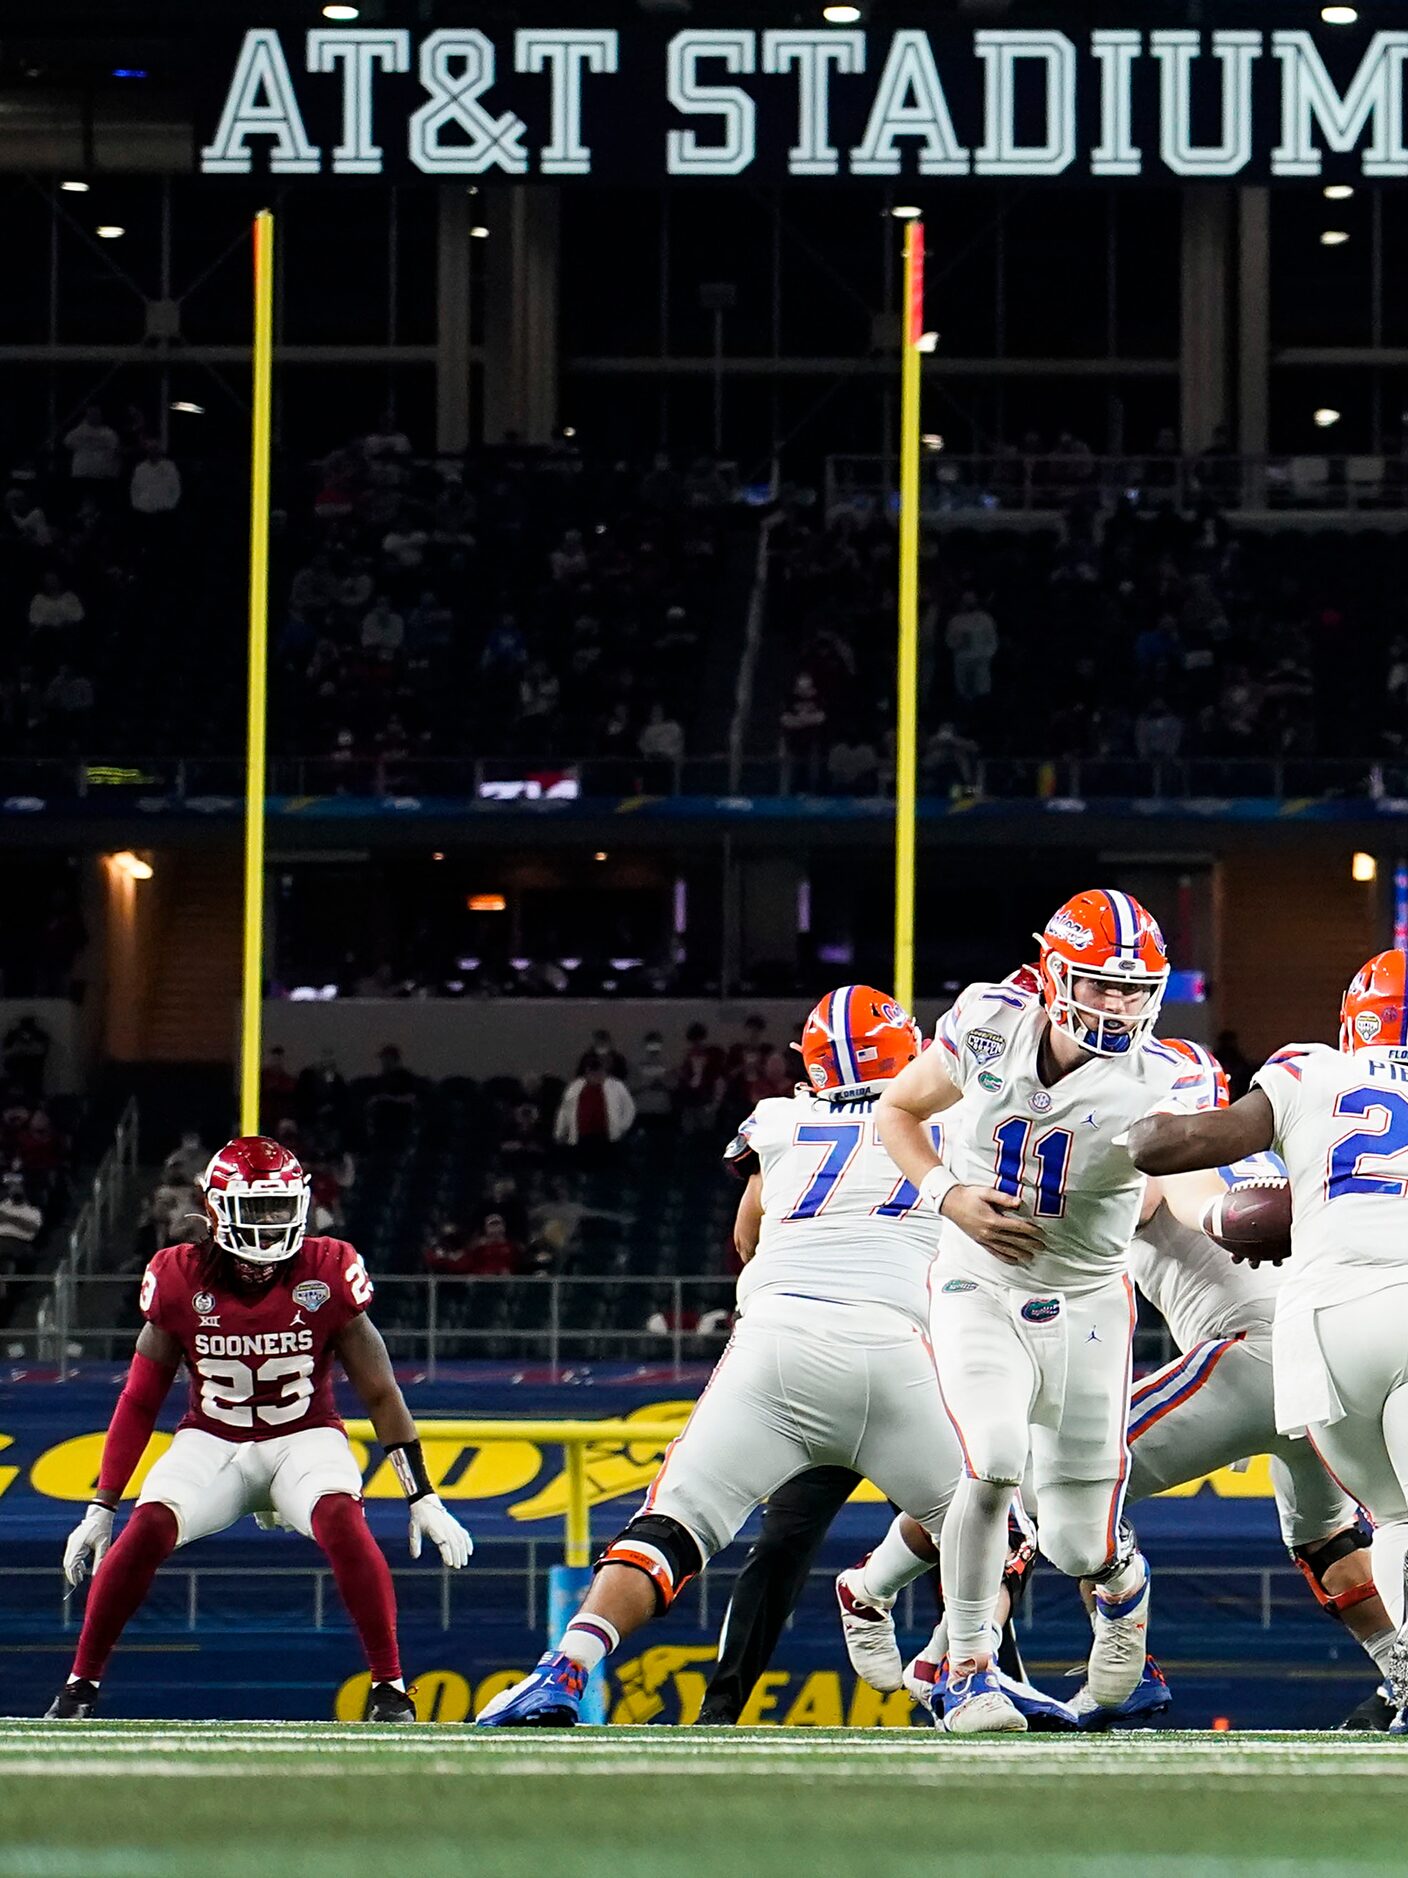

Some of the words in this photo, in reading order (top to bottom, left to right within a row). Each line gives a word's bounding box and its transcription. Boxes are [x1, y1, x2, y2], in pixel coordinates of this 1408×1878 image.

[201, 28, 619, 174] AT&T
[993, 1115, 1073, 1218] 11
[195, 1330, 313, 1356] SOONERS
[196, 1354, 315, 1427] 23
